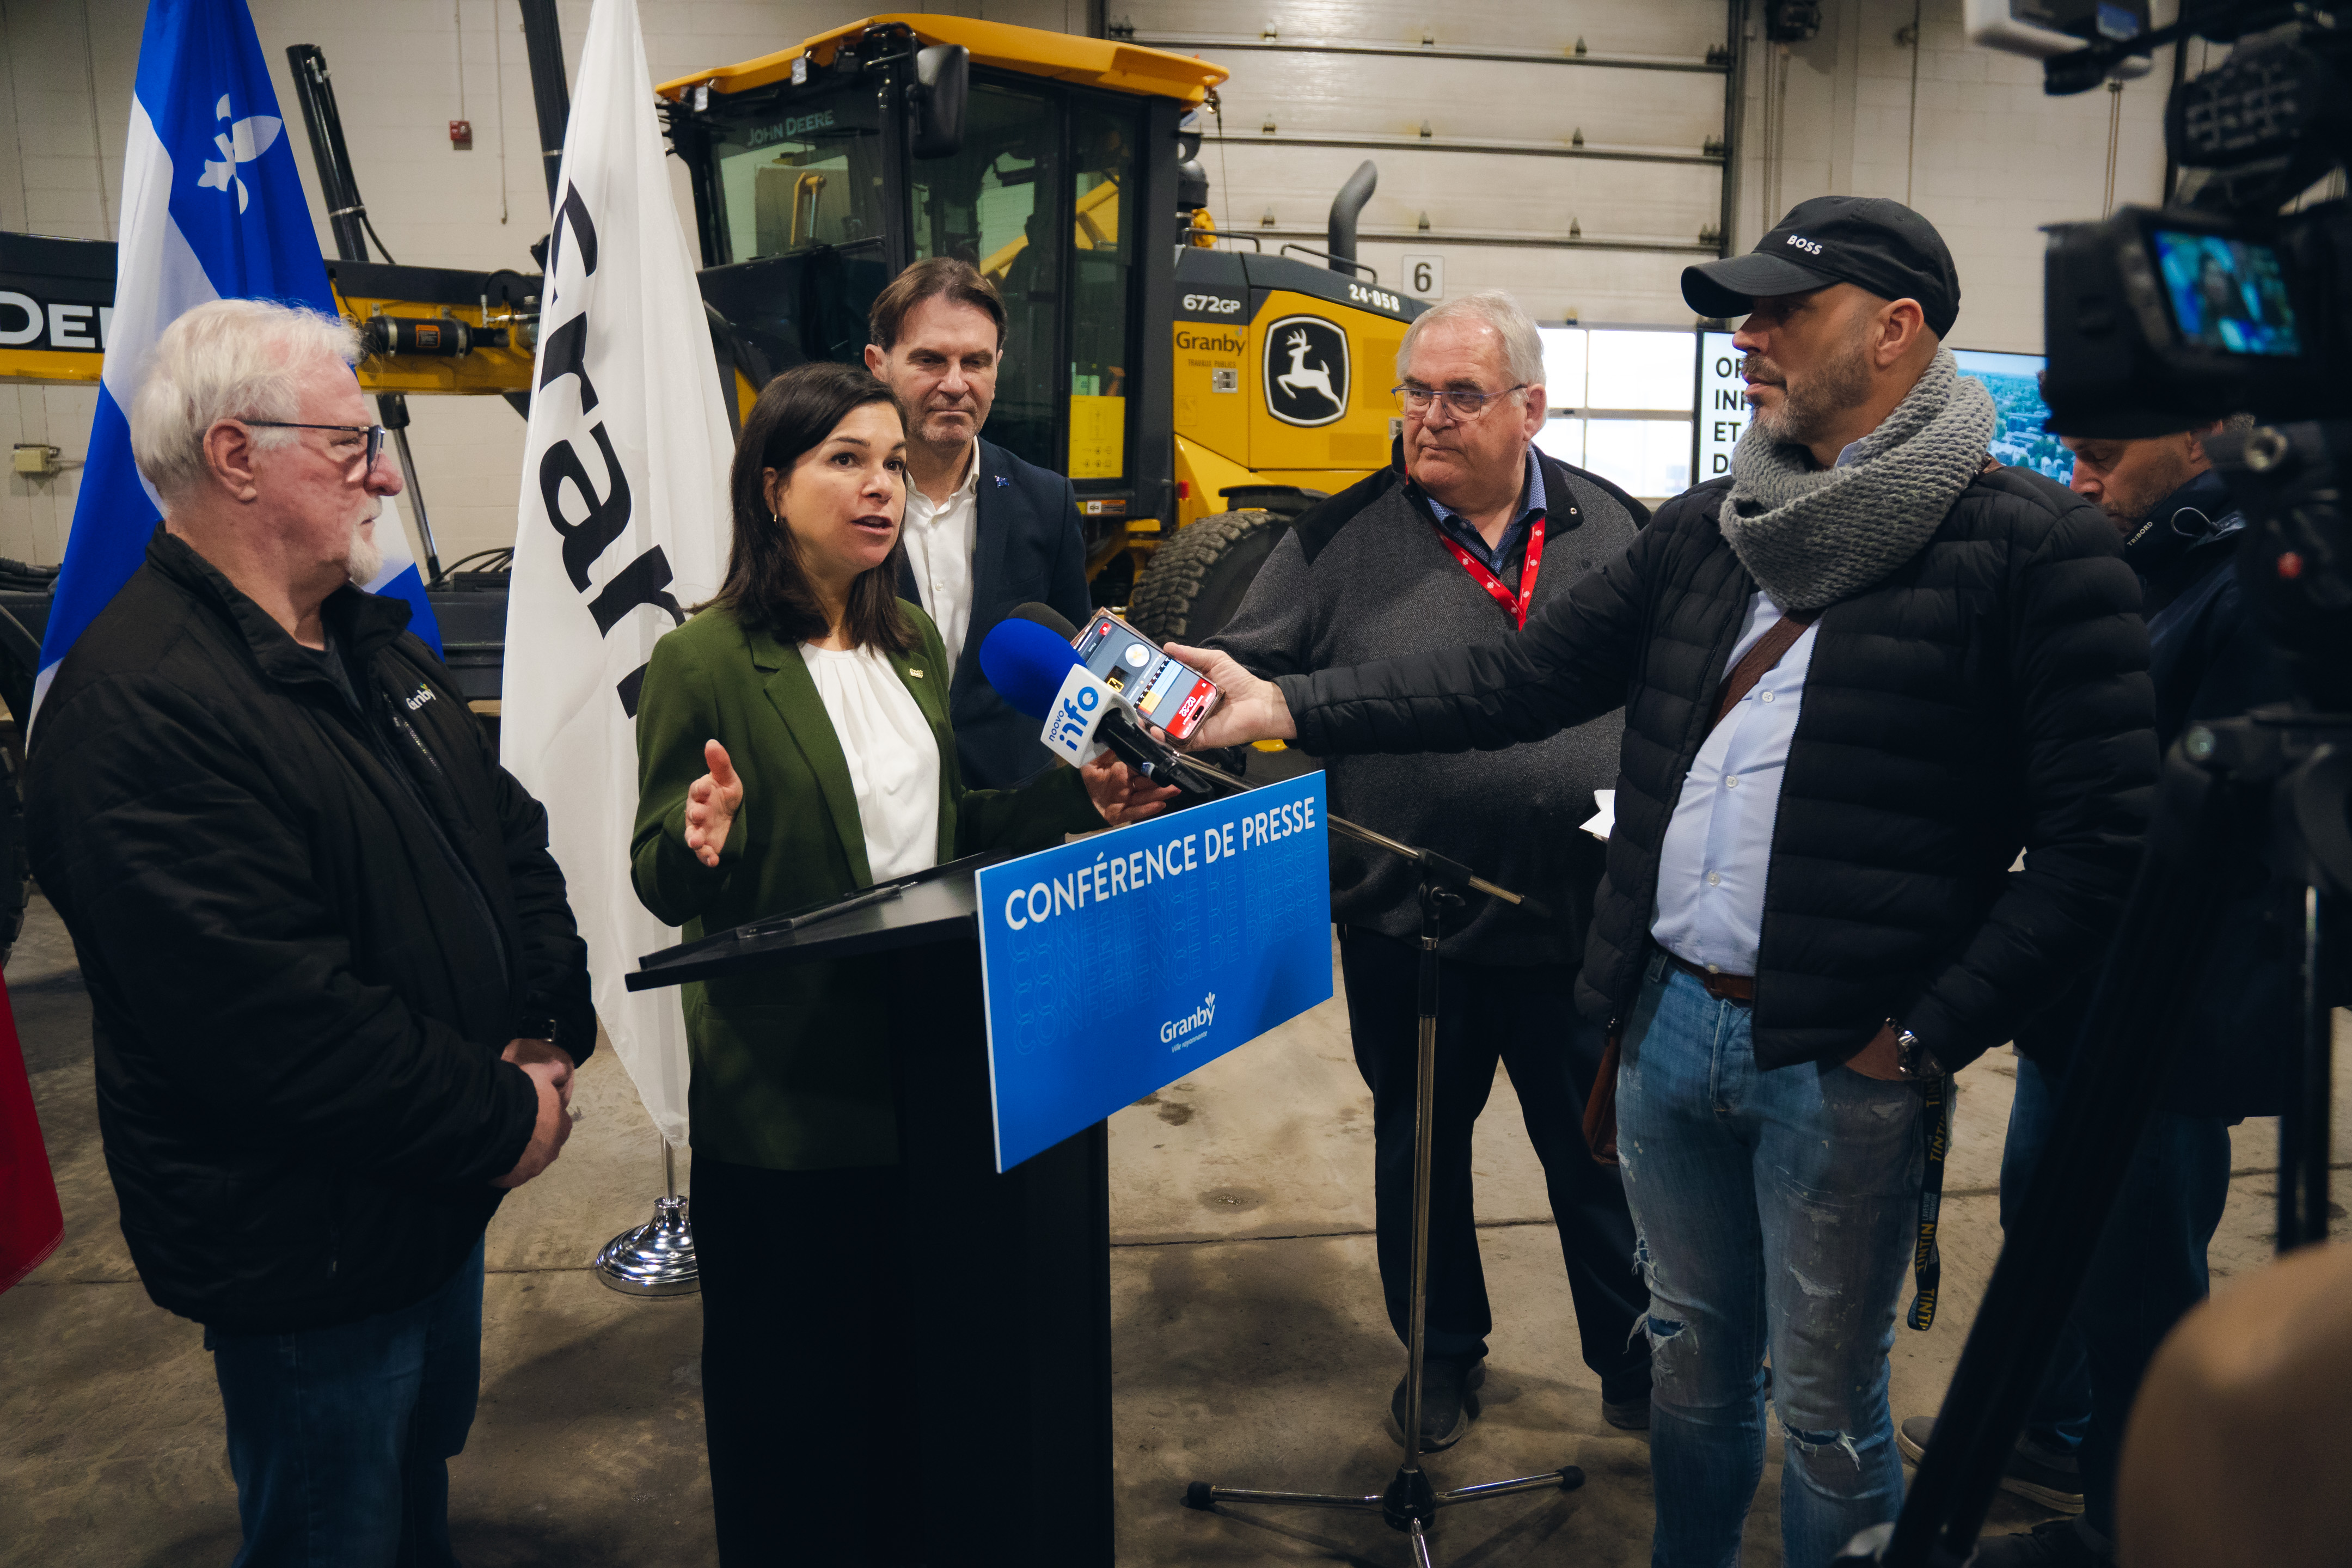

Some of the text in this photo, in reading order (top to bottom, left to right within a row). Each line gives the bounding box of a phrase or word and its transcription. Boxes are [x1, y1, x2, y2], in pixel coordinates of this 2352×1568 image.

[747, 109, 835, 147] JOHN DEERE
[1786, 235, 1823, 255] BOSS
[1414, 261, 1432, 292] 6
[1183, 293, 1241, 314] 672GP
[1176, 330, 1246, 357] Granby
[1214, 360, 1236, 368] PUBLICS
[1714, 421, 1742, 442] ET
[2127, 521, 2153, 546] TRIBORD
[405, 688, 437, 711] Ganby
[1178, 696, 1196, 718] 02:32
[1049, 710, 1064, 742] noovo
[1059, 686, 1099, 751] info
[1005, 796, 1316, 930] CONFÉRENCE DE PRESSE
[1160, 1004, 1215, 1043] Granby
[1172, 1031, 1208, 1054] Ville rayonnante
[1929, 1193, 1938, 1222] IMMERSIVE
[1915, 1223, 1935, 1274] TINTIN
[1918, 1287, 1935, 1331] TINTI
